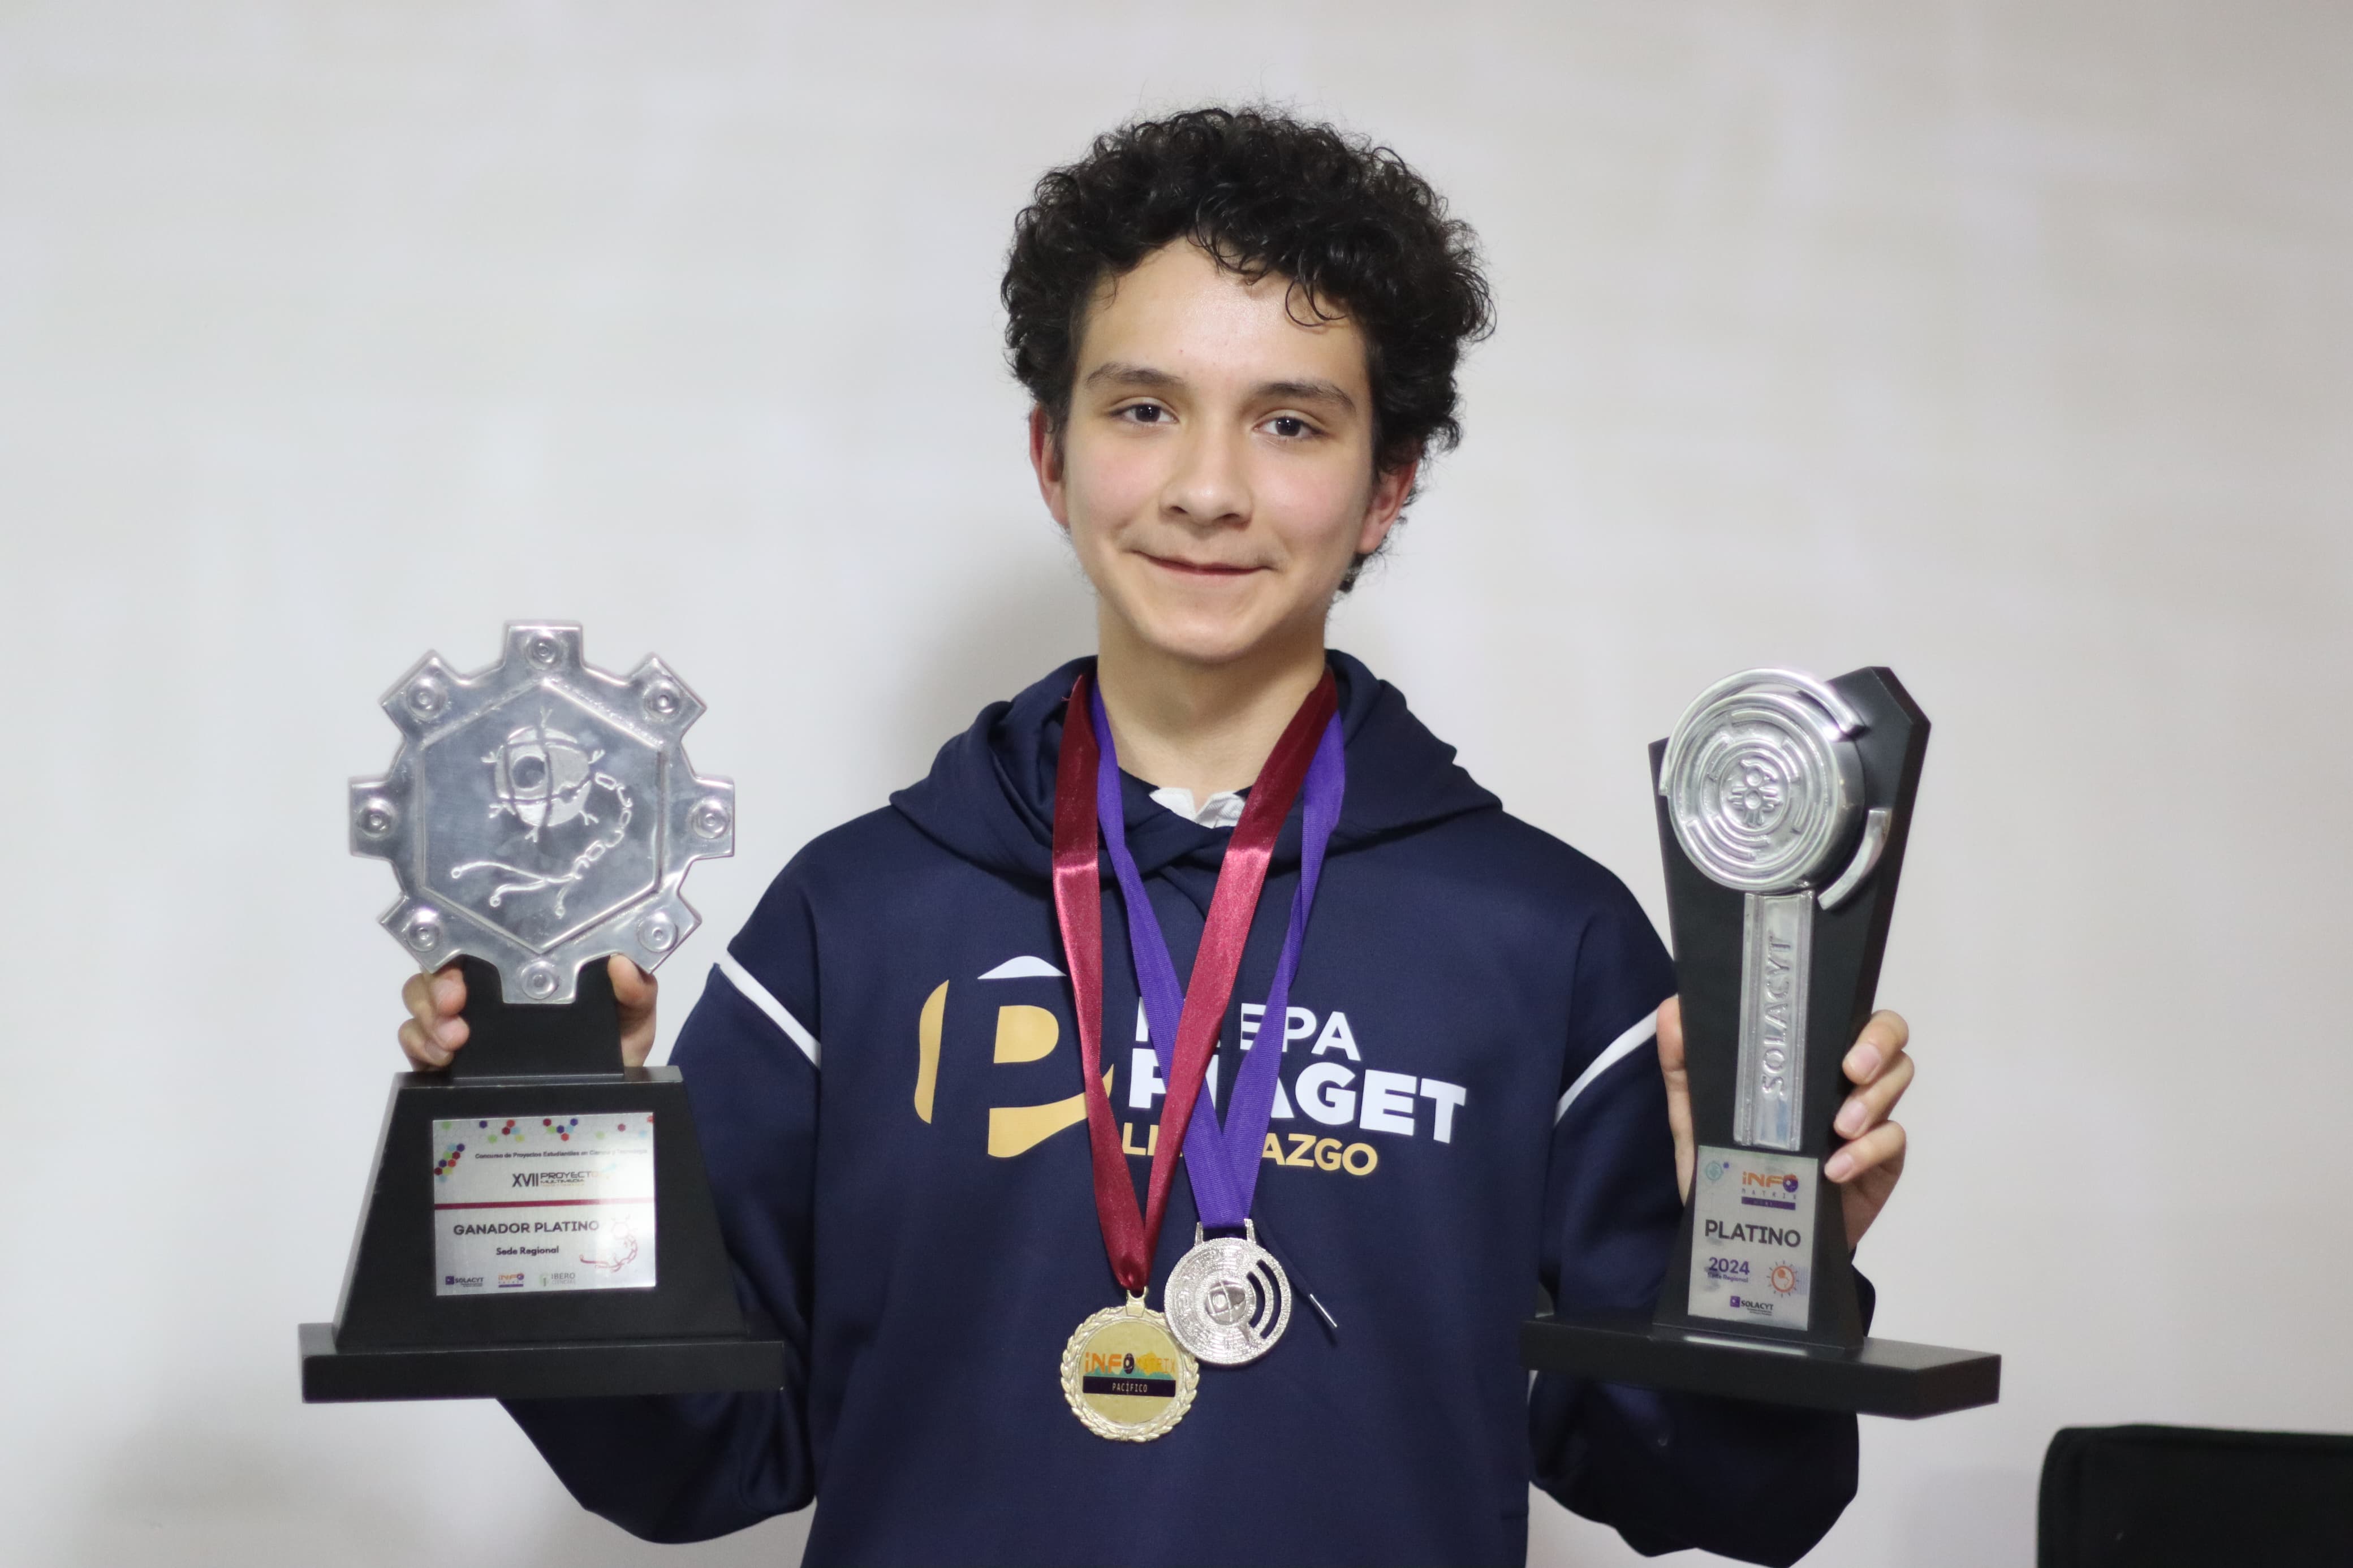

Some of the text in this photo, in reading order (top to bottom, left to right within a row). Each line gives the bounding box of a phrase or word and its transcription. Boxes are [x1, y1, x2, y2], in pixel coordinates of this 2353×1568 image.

[1762, 930, 1791, 1098] SOLACYT
[1135, 996, 1361, 1061] EPA
[1122, 1122, 1377, 1176] LIAZGO
[512, 1172, 539, 1187] XVII
[453, 1220, 600, 1235] GANADOR PLATINO
[1704, 1219, 1802, 1248] PLATINO
[495, 1246, 559, 1256] Sede Regional
[1709, 1256, 1750, 1275] 2024
[1741, 1300, 1774, 1310] SOLACYT
[1111, 1381, 1148, 1393] PACÍFICO
